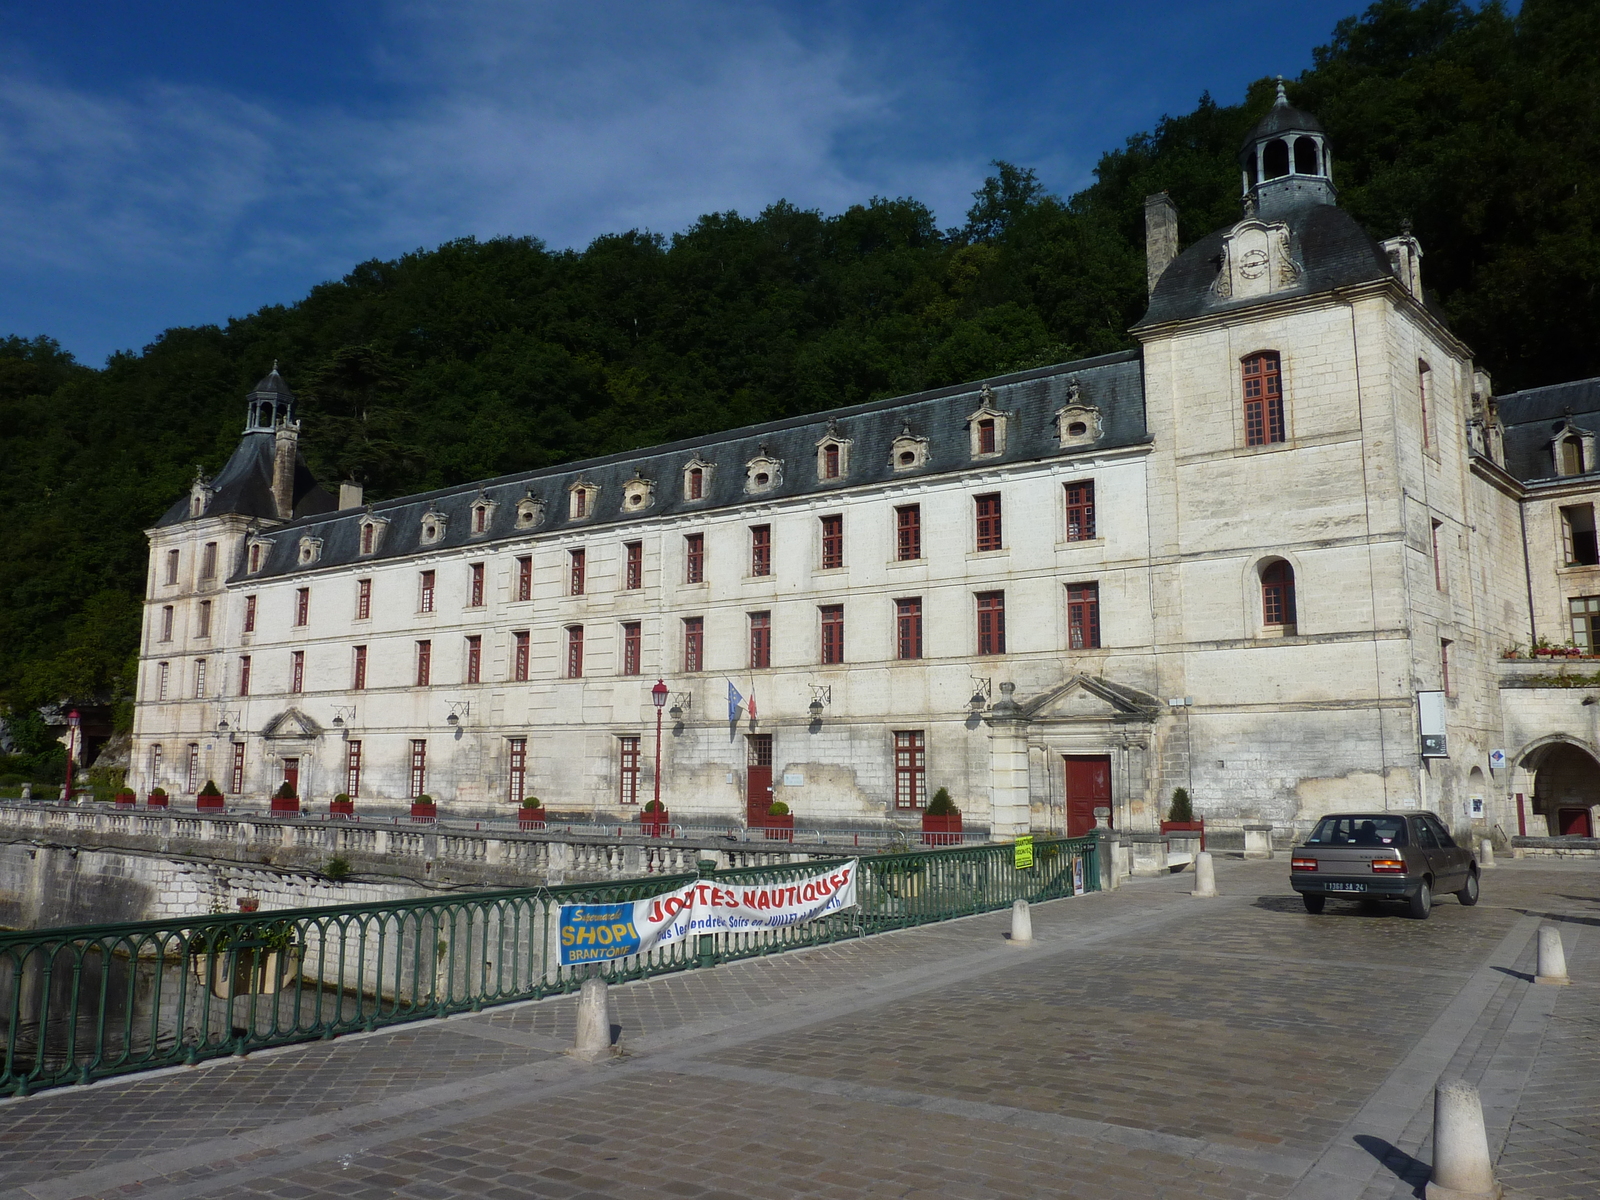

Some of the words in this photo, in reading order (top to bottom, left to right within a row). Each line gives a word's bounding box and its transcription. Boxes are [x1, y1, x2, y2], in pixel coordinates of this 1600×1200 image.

[648, 885, 740, 922] JOUTES
[743, 869, 850, 910] NAUTIQUES
[1355, 883, 1364, 891] 24
[729, 915, 749, 928] Soirs
[751, 919, 763, 927] en
[764, 912, 798, 927] JUILLET
[561, 922, 638, 946] SHOPI
[569, 945, 631, 962] BRANTÔME
